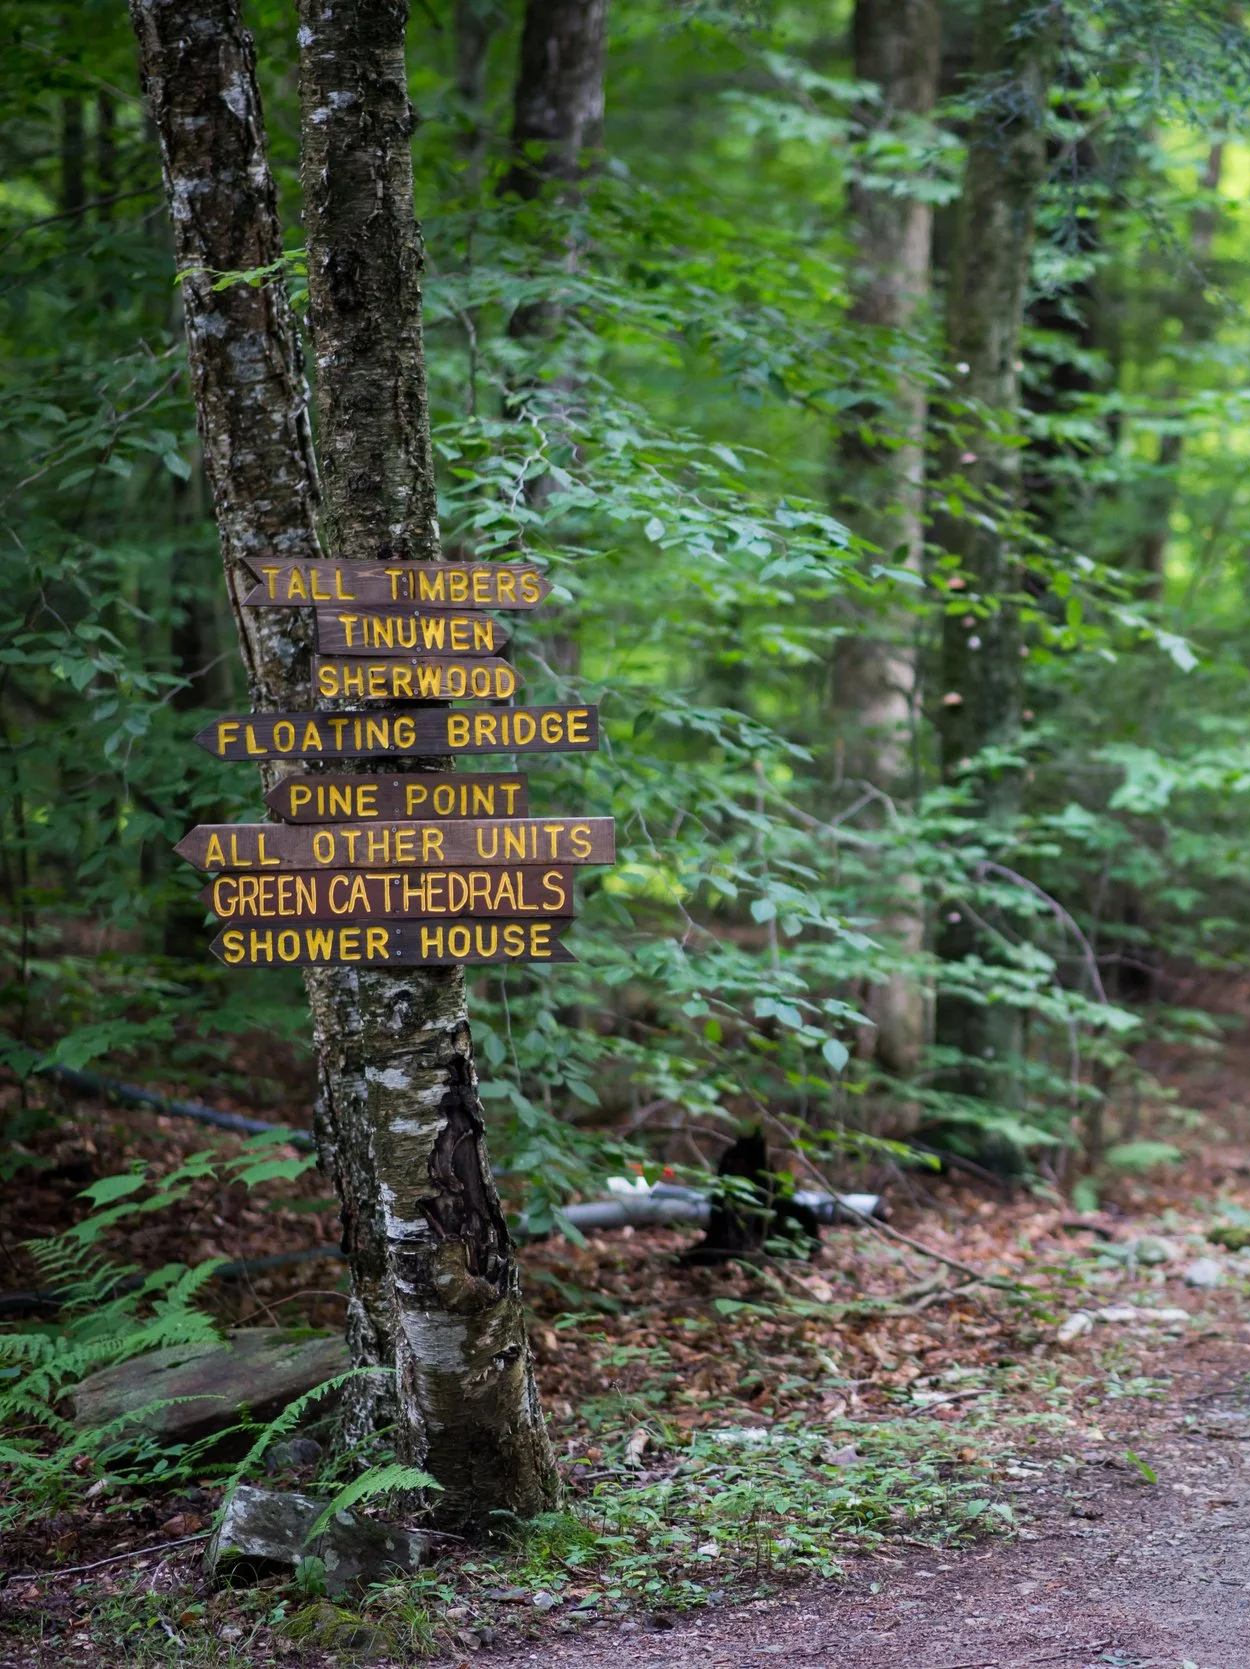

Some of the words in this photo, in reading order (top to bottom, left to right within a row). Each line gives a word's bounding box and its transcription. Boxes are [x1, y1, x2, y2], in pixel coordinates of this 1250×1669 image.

[261, 566, 355, 600] TALL
[384, 567, 541, 603] TIMBERS
[338, 614, 494, 651] TINUWEN
[318, 664, 515, 698] SHERWOOD
[217, 716, 416, 755] FLOATING
[447, 709, 590, 747] BRIDGE
[290, 784, 379, 817] PINE
[406, 783, 521, 816] POINT
[205, 832, 280, 868] ALL
[313, 827, 444, 864] OTHER
[476, 824, 592, 859] UNITS
[213, 875, 317, 917] GREEN
[328, 871, 566, 914] CATHEDRALS
[222, 926, 390, 963] SHOWER
[420, 923, 552, 959] HOUSE
